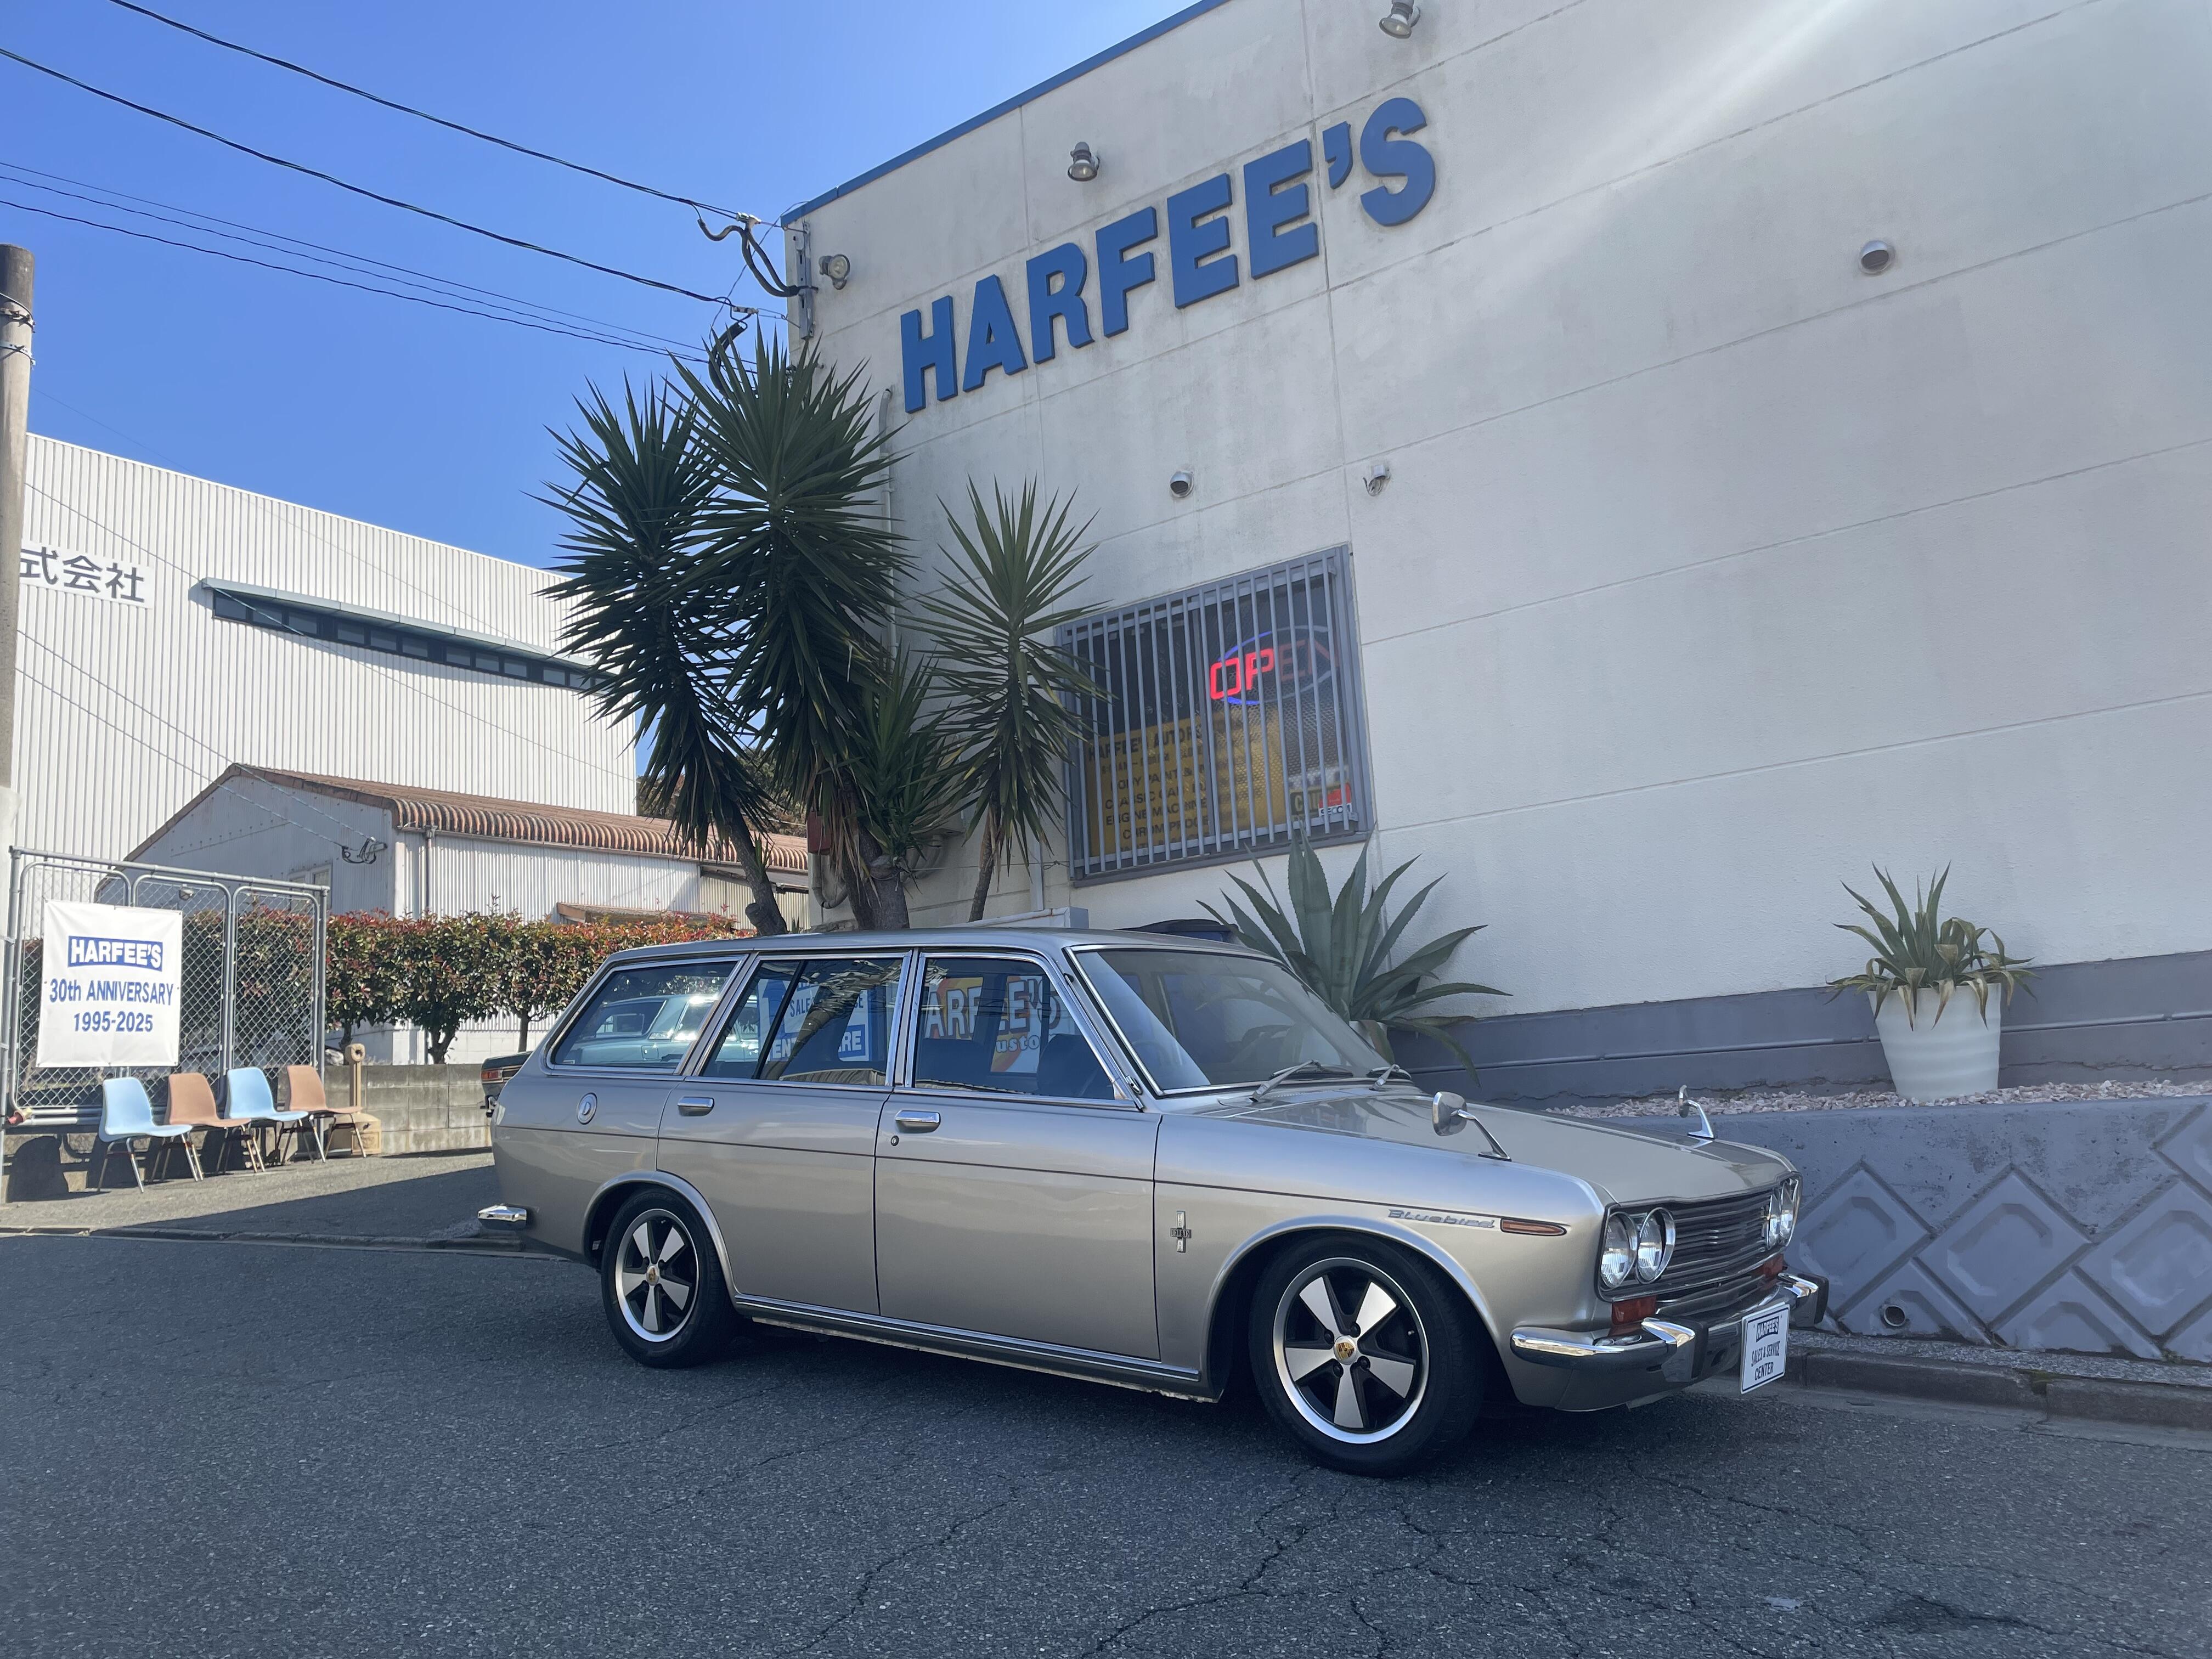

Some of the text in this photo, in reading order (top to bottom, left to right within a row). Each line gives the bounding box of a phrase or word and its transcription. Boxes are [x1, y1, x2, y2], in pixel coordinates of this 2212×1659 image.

[901, 97, 1436, 414] HARFEE'S
[20, 546, 145, 602] 式会社
[71, 939, 162, 968] HARFEE'S
[49, 978, 174, 1006] 30th ANNIVERSARY
[789, 996, 814, 1017] SALE
[74, 1011, 154, 1032] 1995-2025
[996, 1035, 1040, 1053] usto
[1757, 1318, 1779, 1339] HARFEE'S
[1751, 1346, 1763, 1367] SALES
[1767, 1341, 1780, 1358] SERVICE
[1754, 1362, 1774, 1381] CENTER
